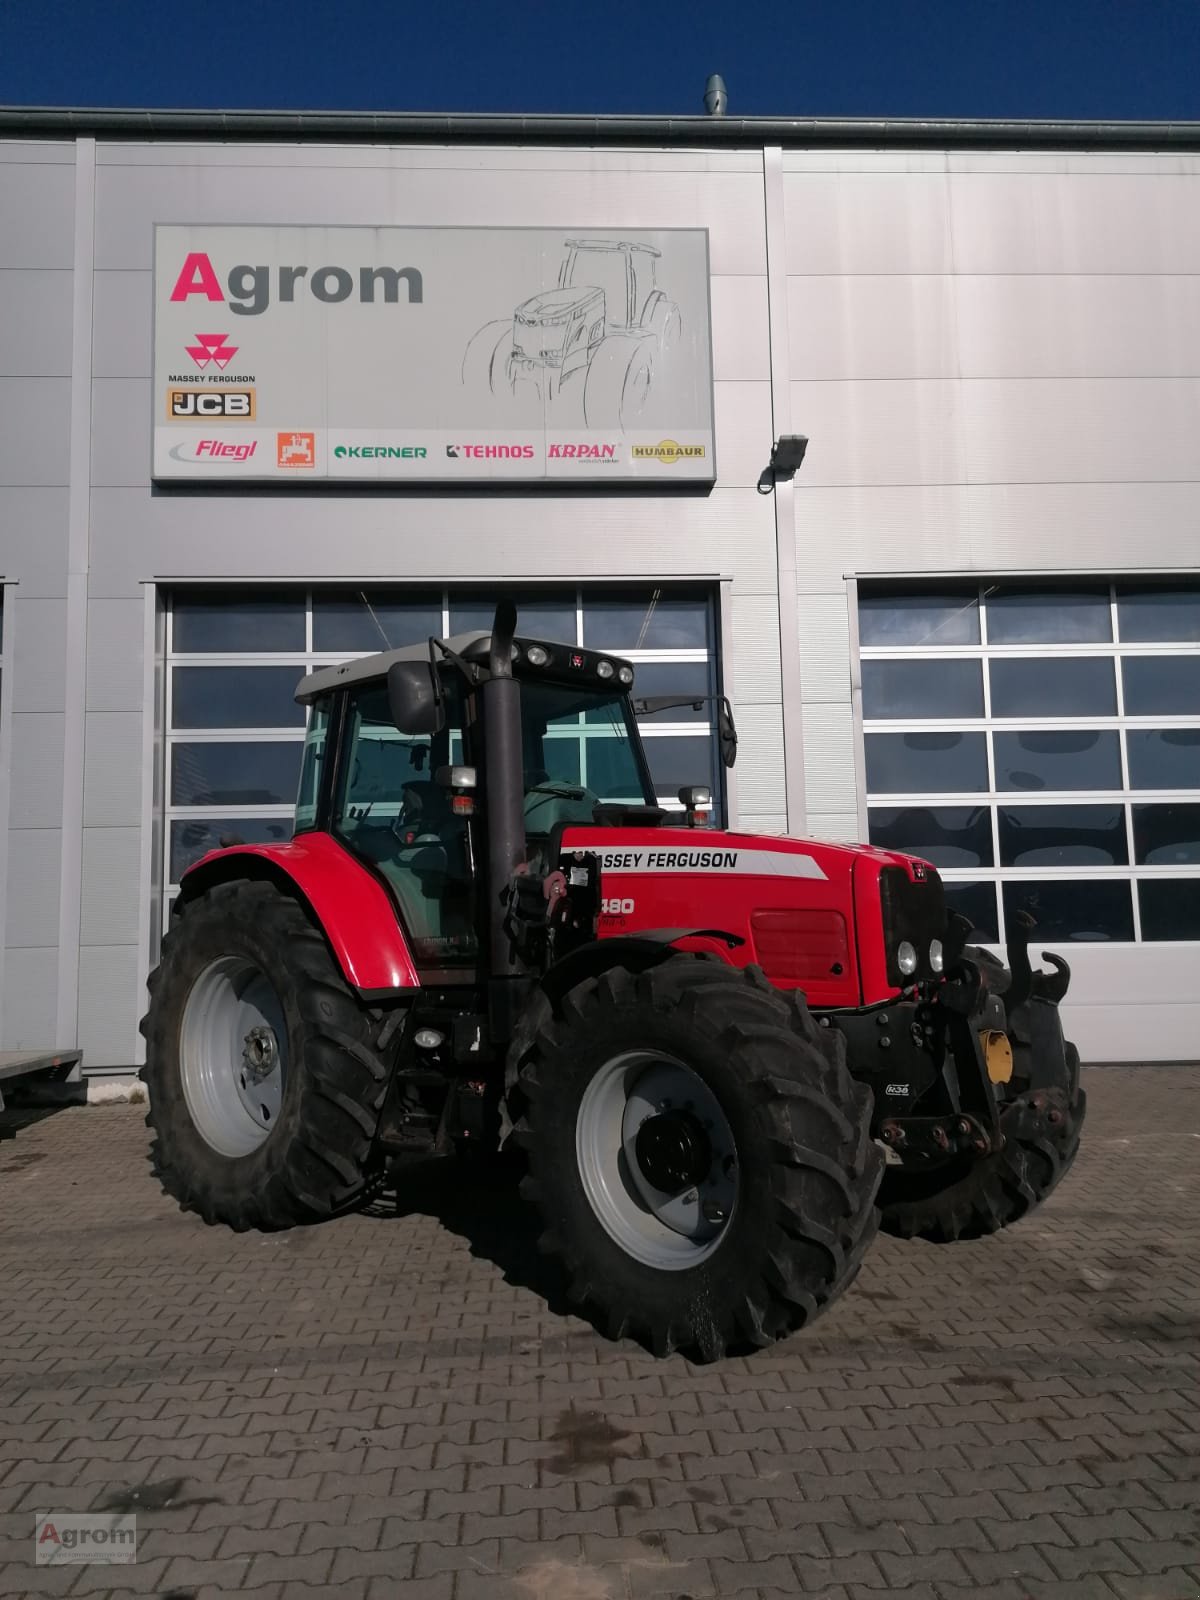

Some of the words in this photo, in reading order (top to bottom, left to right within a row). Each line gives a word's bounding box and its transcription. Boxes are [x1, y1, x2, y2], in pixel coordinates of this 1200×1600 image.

[170, 253, 423, 315] Agrom
[168, 375, 205, 383] MASSEY
[208, 375, 255, 383] FERGUSON
[174, 393, 249, 415] JCB
[195, 440, 257, 461] Fliegl
[348, 447, 427, 458] KERNER
[463, 445, 534, 457] TEHNOS
[548, 444, 616, 457] KRPAN
[635, 447, 702, 456] HUMBAUR
[601, 853, 643, 868] SSEY
[647, 853, 737, 868] FERGUSON
[601, 899, 634, 914] 480
